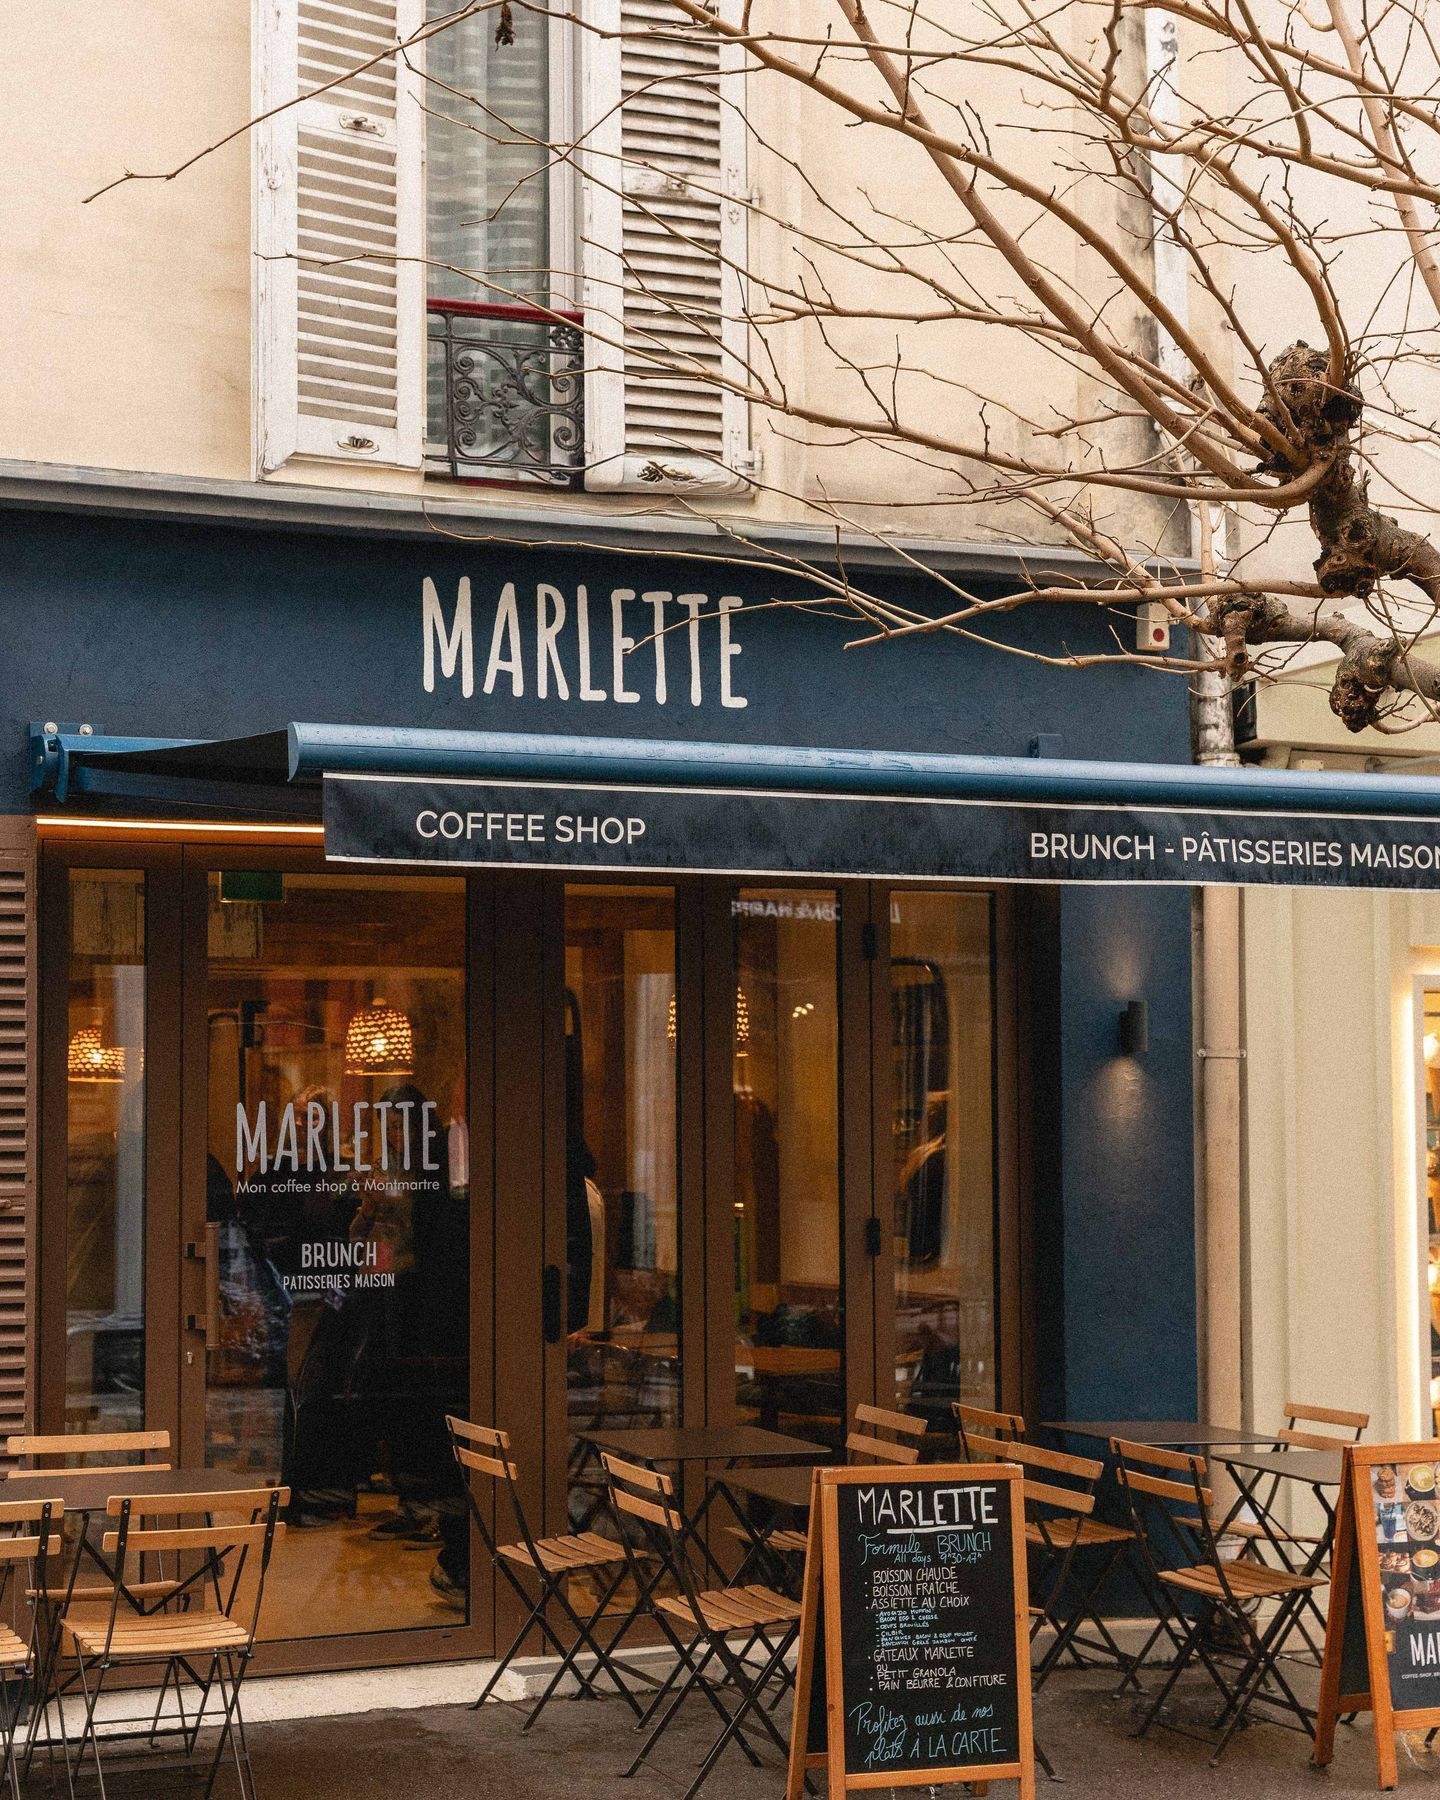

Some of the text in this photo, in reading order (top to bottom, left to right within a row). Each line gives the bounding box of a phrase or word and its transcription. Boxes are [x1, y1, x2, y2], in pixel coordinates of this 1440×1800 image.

[423, 576, 748, 708] MARLETTE
[416, 811, 646, 844] COFFEE SHOP
[1031, 832, 1154, 860] BRUNCH
[1182, 832, 1342, 867] PÂTISSERIES
[236, 1101, 440, 1175] MARLETTE
[236, 1179, 440, 1195] Mon coffee shop à Montmartre
[301, 1242, 377, 1268] BRUNCH
[283, 1273, 395, 1290] PATISSERIES MAISON
[858, 1486, 999, 1526] MARLETTE
[858, 1531, 992, 1566] Formule BRUNCH
[894, 1554, 906, 1563] All
[911, 1553, 932, 1567] days
[873, 1566, 958, 1584] BOISSON CHAUDE
[872, 1583, 912, 1598] BOISSON
[870, 1596, 969, 1610] ASSIETTE AU CHOIX
[873, 1646, 974, 1662] GÂTEAUX MARLETTE
[876, 1663, 888, 1672] OU
[877, 1666, 956, 1680] PETIT GRANOLA
[878, 1680, 900, 1691] PAIN
[906, 1678, 940, 1689] BEURRE
[849, 1701, 993, 1739] Profitez aussi de nos
[928, 1734, 947, 1758] LA
[952, 1728, 1007, 1756] CARTE
